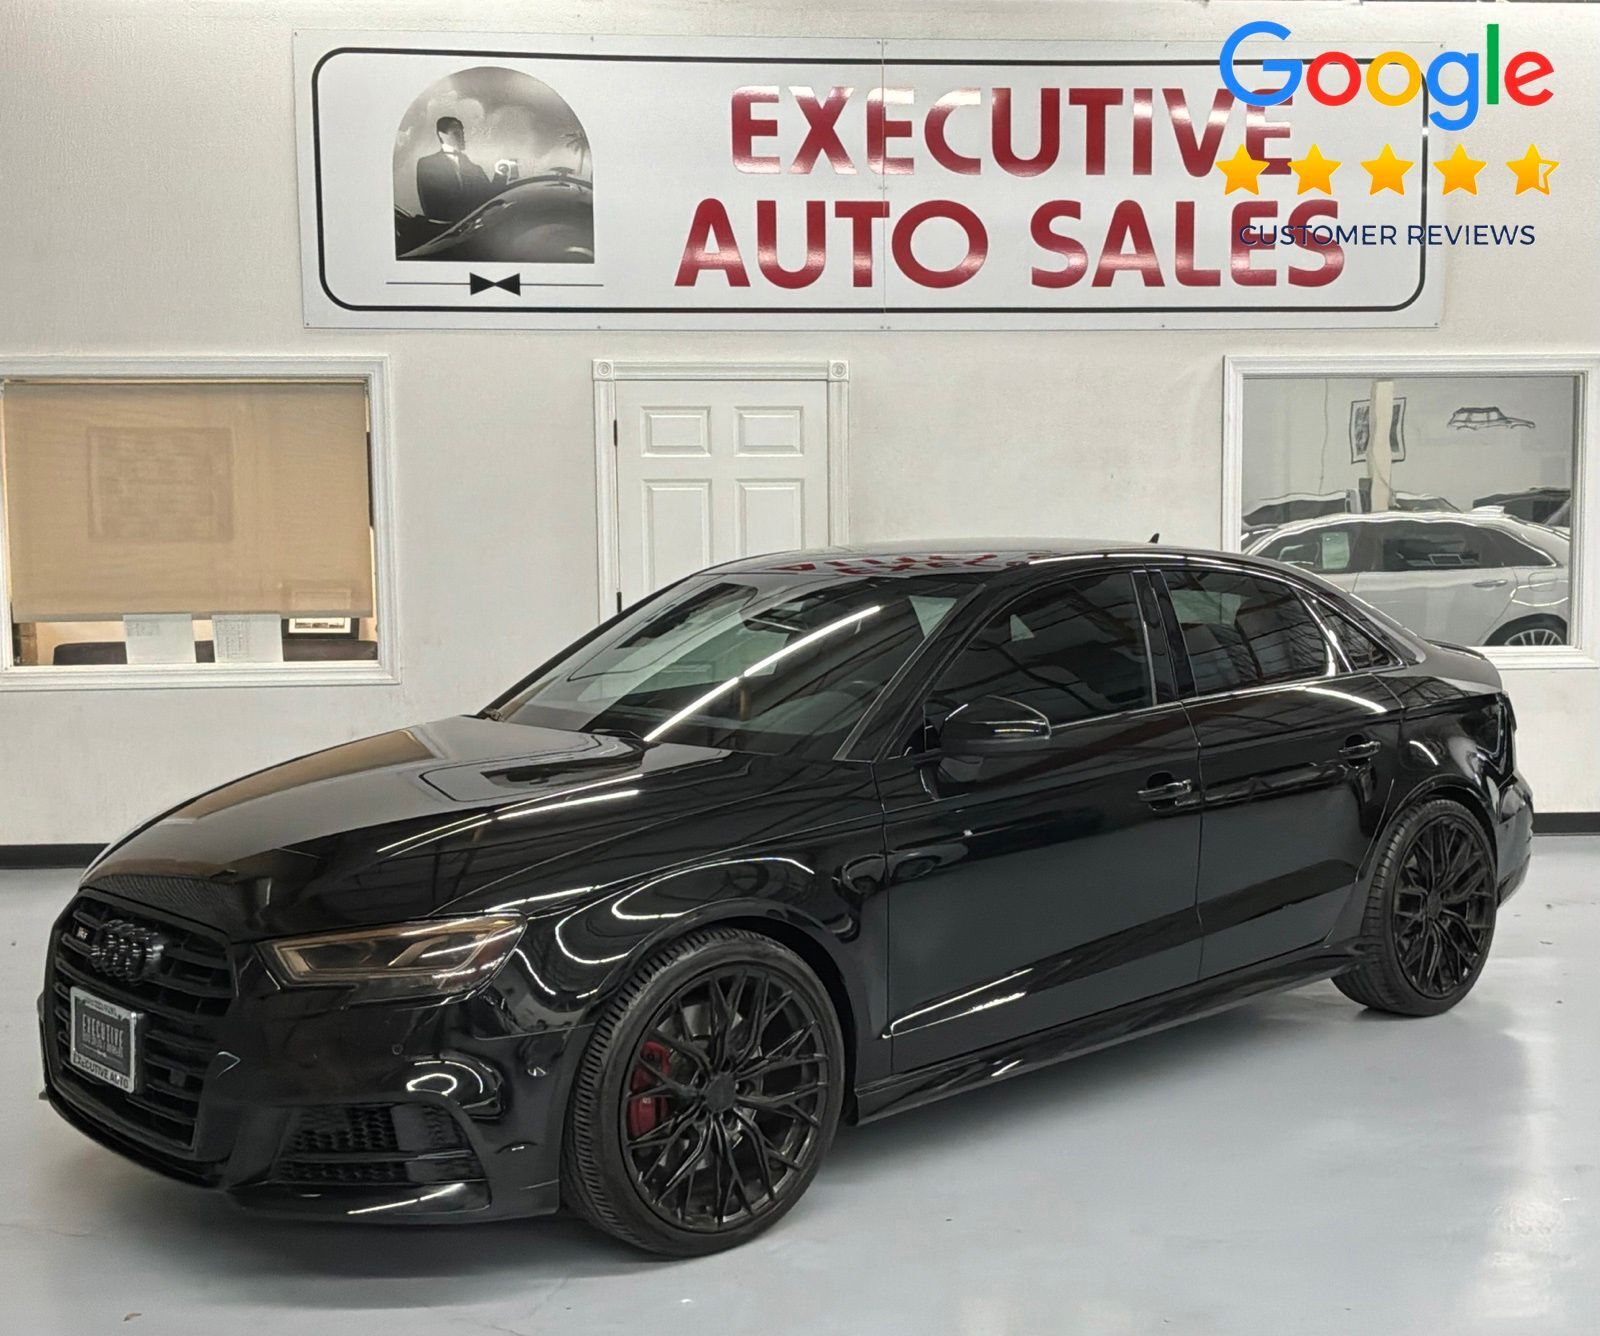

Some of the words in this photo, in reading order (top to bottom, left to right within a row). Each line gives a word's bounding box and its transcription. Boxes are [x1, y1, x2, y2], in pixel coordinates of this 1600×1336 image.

[731, 85, 1294, 178] EXECUTIVE
[674, 198, 989, 289] AUTO
[1030, 199, 1345, 288] SALES
